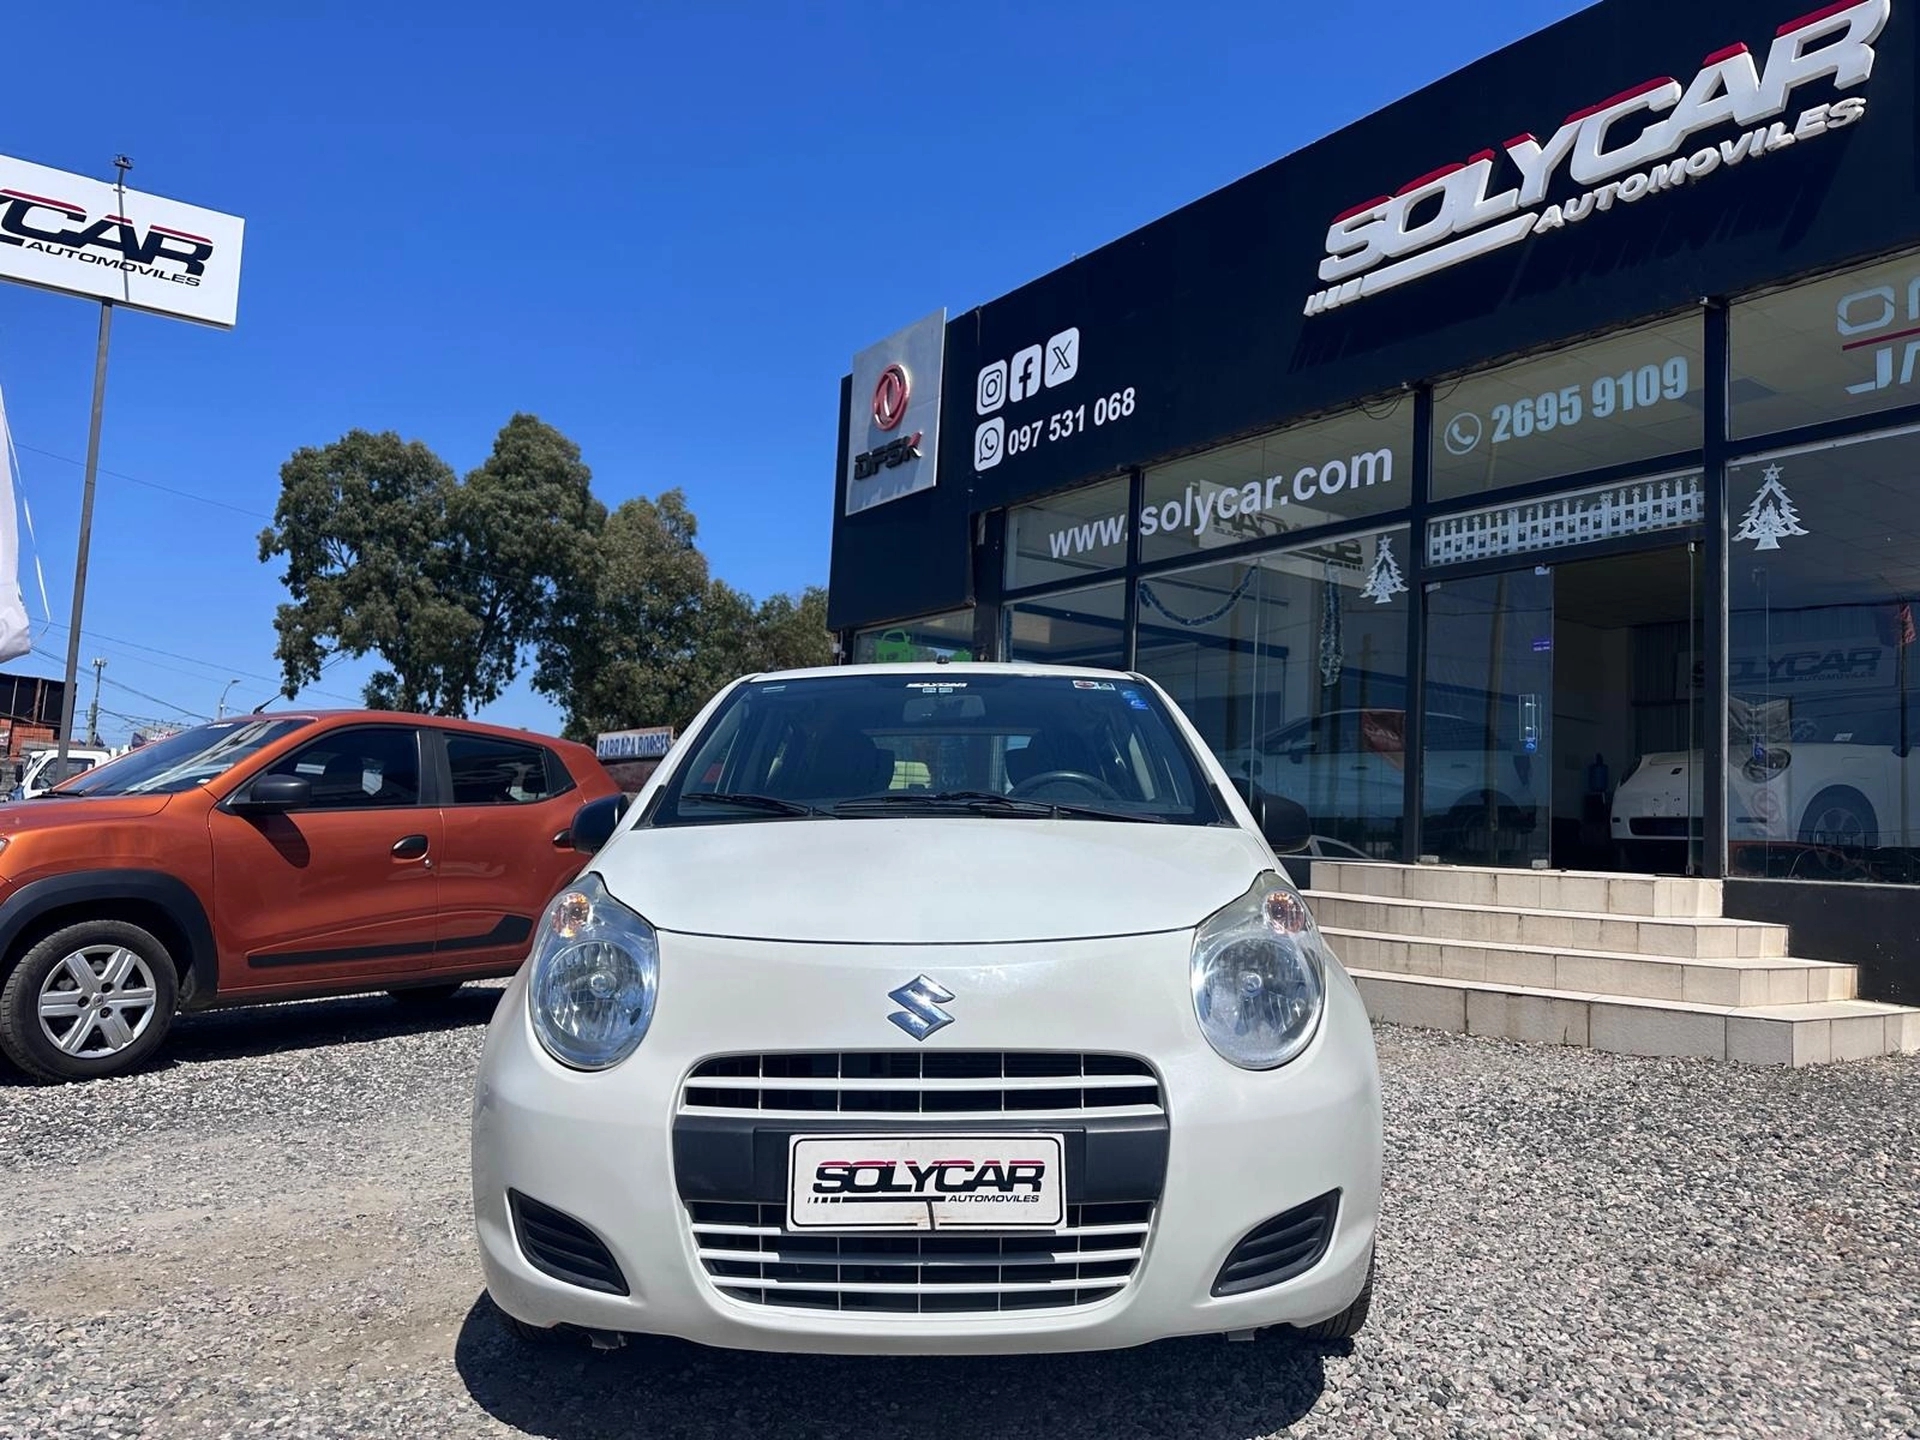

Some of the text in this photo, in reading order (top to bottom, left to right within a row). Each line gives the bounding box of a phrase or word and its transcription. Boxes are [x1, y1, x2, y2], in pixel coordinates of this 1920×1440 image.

[1318, 0, 1891, 282] SOLYCAR
[1533, 97, 1867, 234] AUTOMOVILES
[0, 189, 213, 277] CAR
[26, 239, 201, 287] AUTOMOVILES
[1007, 387, 1136, 455] 097 531 068
[1491, 355, 1689, 443] 2695 9109
[812, 1160, 1045, 1194] SOLYCAR
[948, 1194, 1040, 1204] AUTOMOVILES
